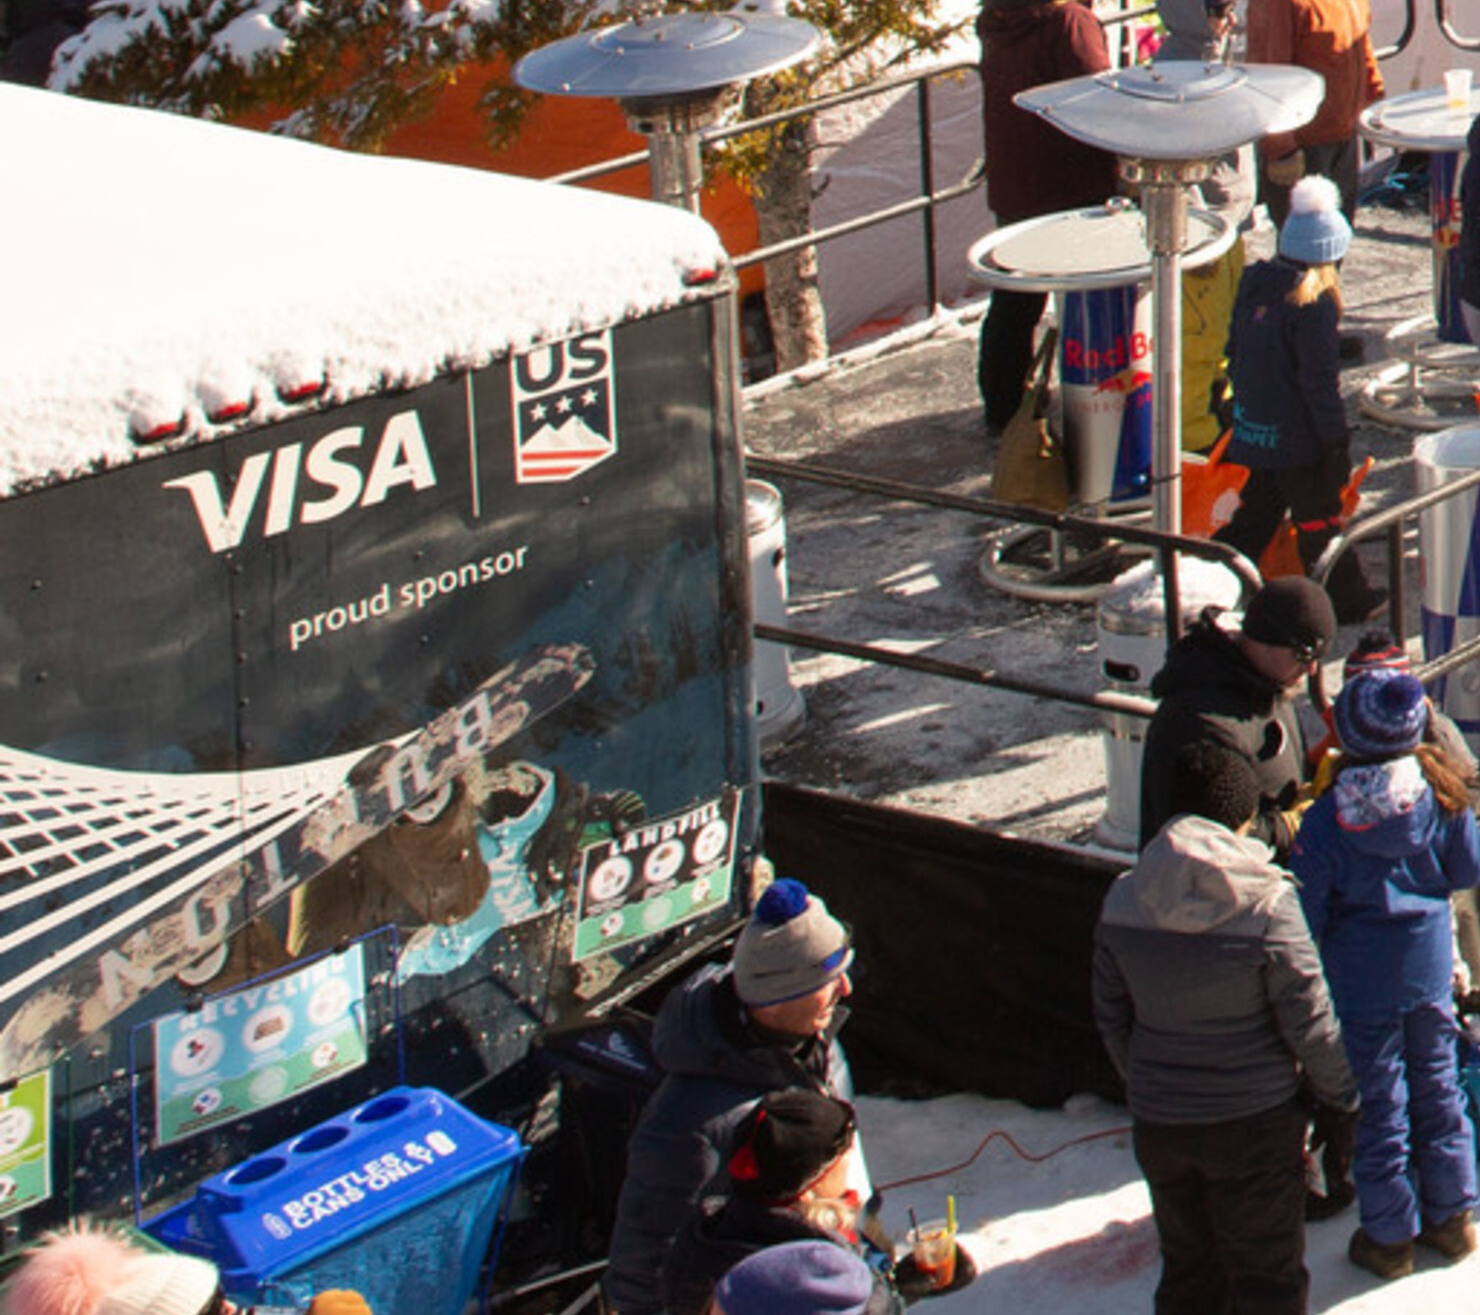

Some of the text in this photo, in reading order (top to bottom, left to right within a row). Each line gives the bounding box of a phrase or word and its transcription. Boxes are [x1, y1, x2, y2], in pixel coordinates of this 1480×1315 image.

[1065, 334, 1126, 369] Red
[161, 409, 437, 554] VISA
[289, 545, 529, 651] proud sponsor
[609, 802, 721, 857] LANDFILL
[178, 954, 346, 1033] RECYCLING
[282, 1152, 400, 1218] BOTTLES
[291, 1158, 434, 1230] CANS ONLY
